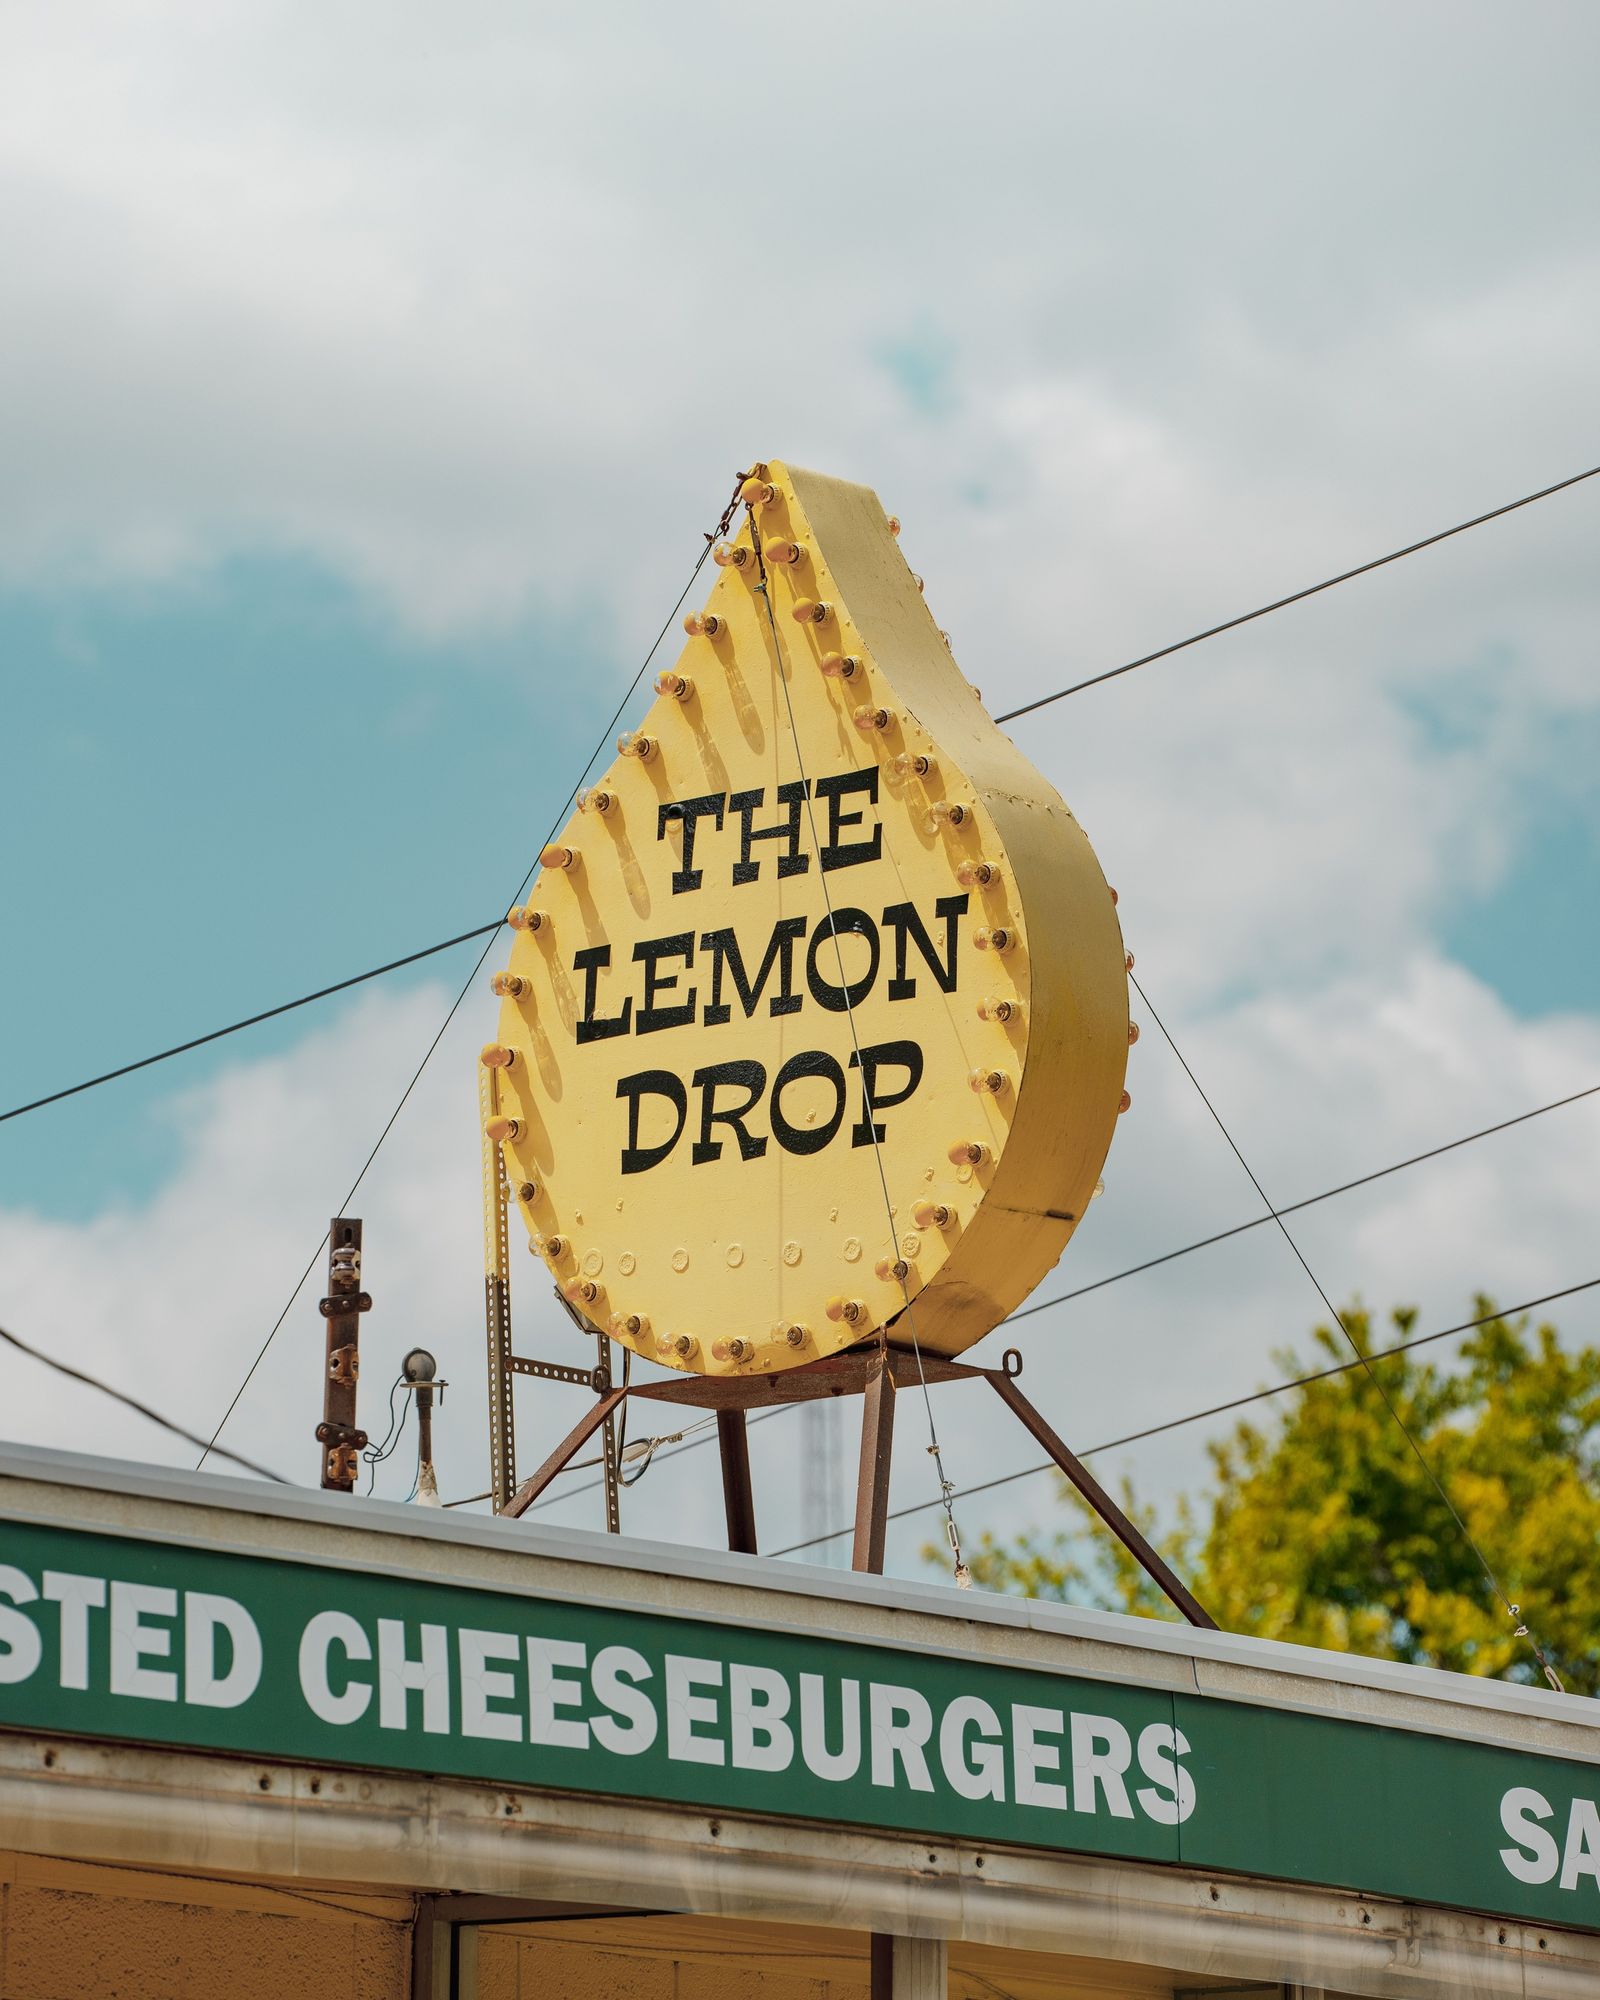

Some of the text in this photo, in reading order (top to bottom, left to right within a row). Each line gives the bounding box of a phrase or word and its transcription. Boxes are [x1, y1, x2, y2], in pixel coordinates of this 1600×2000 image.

[657, 765, 882, 894] THE
[574, 894, 969, 1045] LEMON
[615, 1040, 924, 1175] DROP
[299, 1611, 1197, 1825] CHEESEBURGERS
[1499, 1787, 1600, 1892] SA
